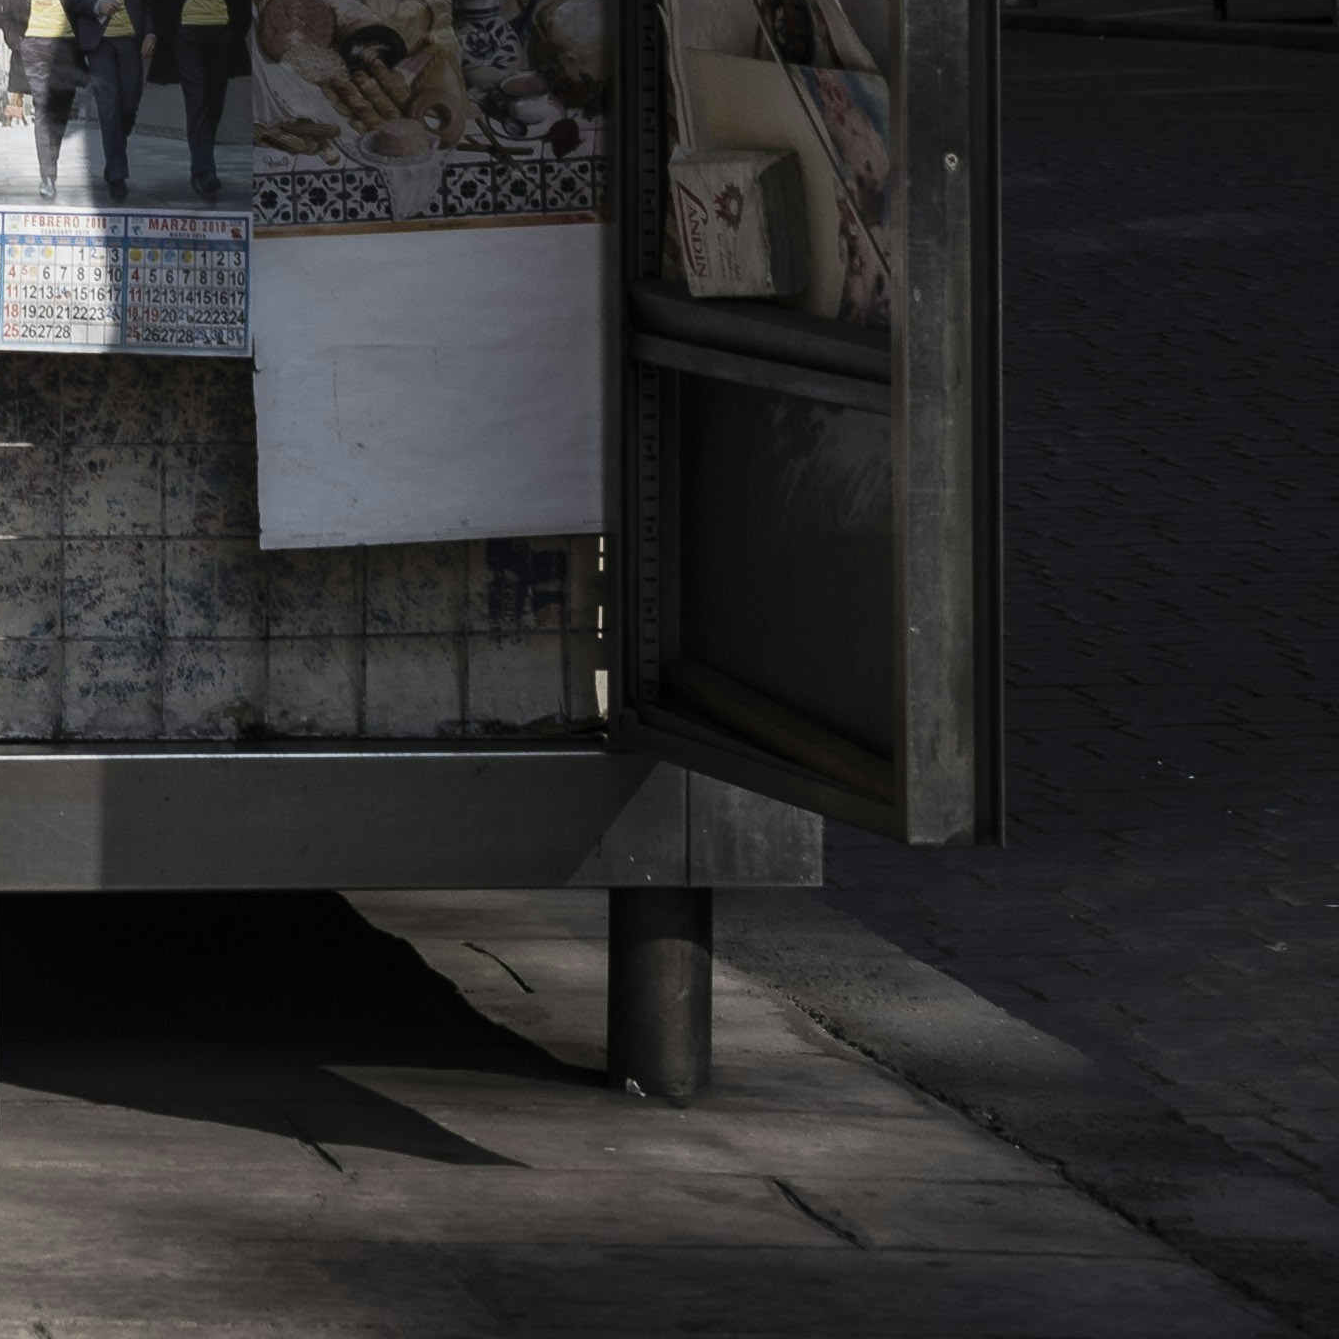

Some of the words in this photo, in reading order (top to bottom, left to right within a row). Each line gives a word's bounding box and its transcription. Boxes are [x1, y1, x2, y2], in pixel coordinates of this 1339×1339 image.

[24, 216, 80, 229] FEBRERO
[86, 216, 107, 229] 2018
[149, 218, 198, 232] MARZO
[202, 220, 228, 233] 2018
